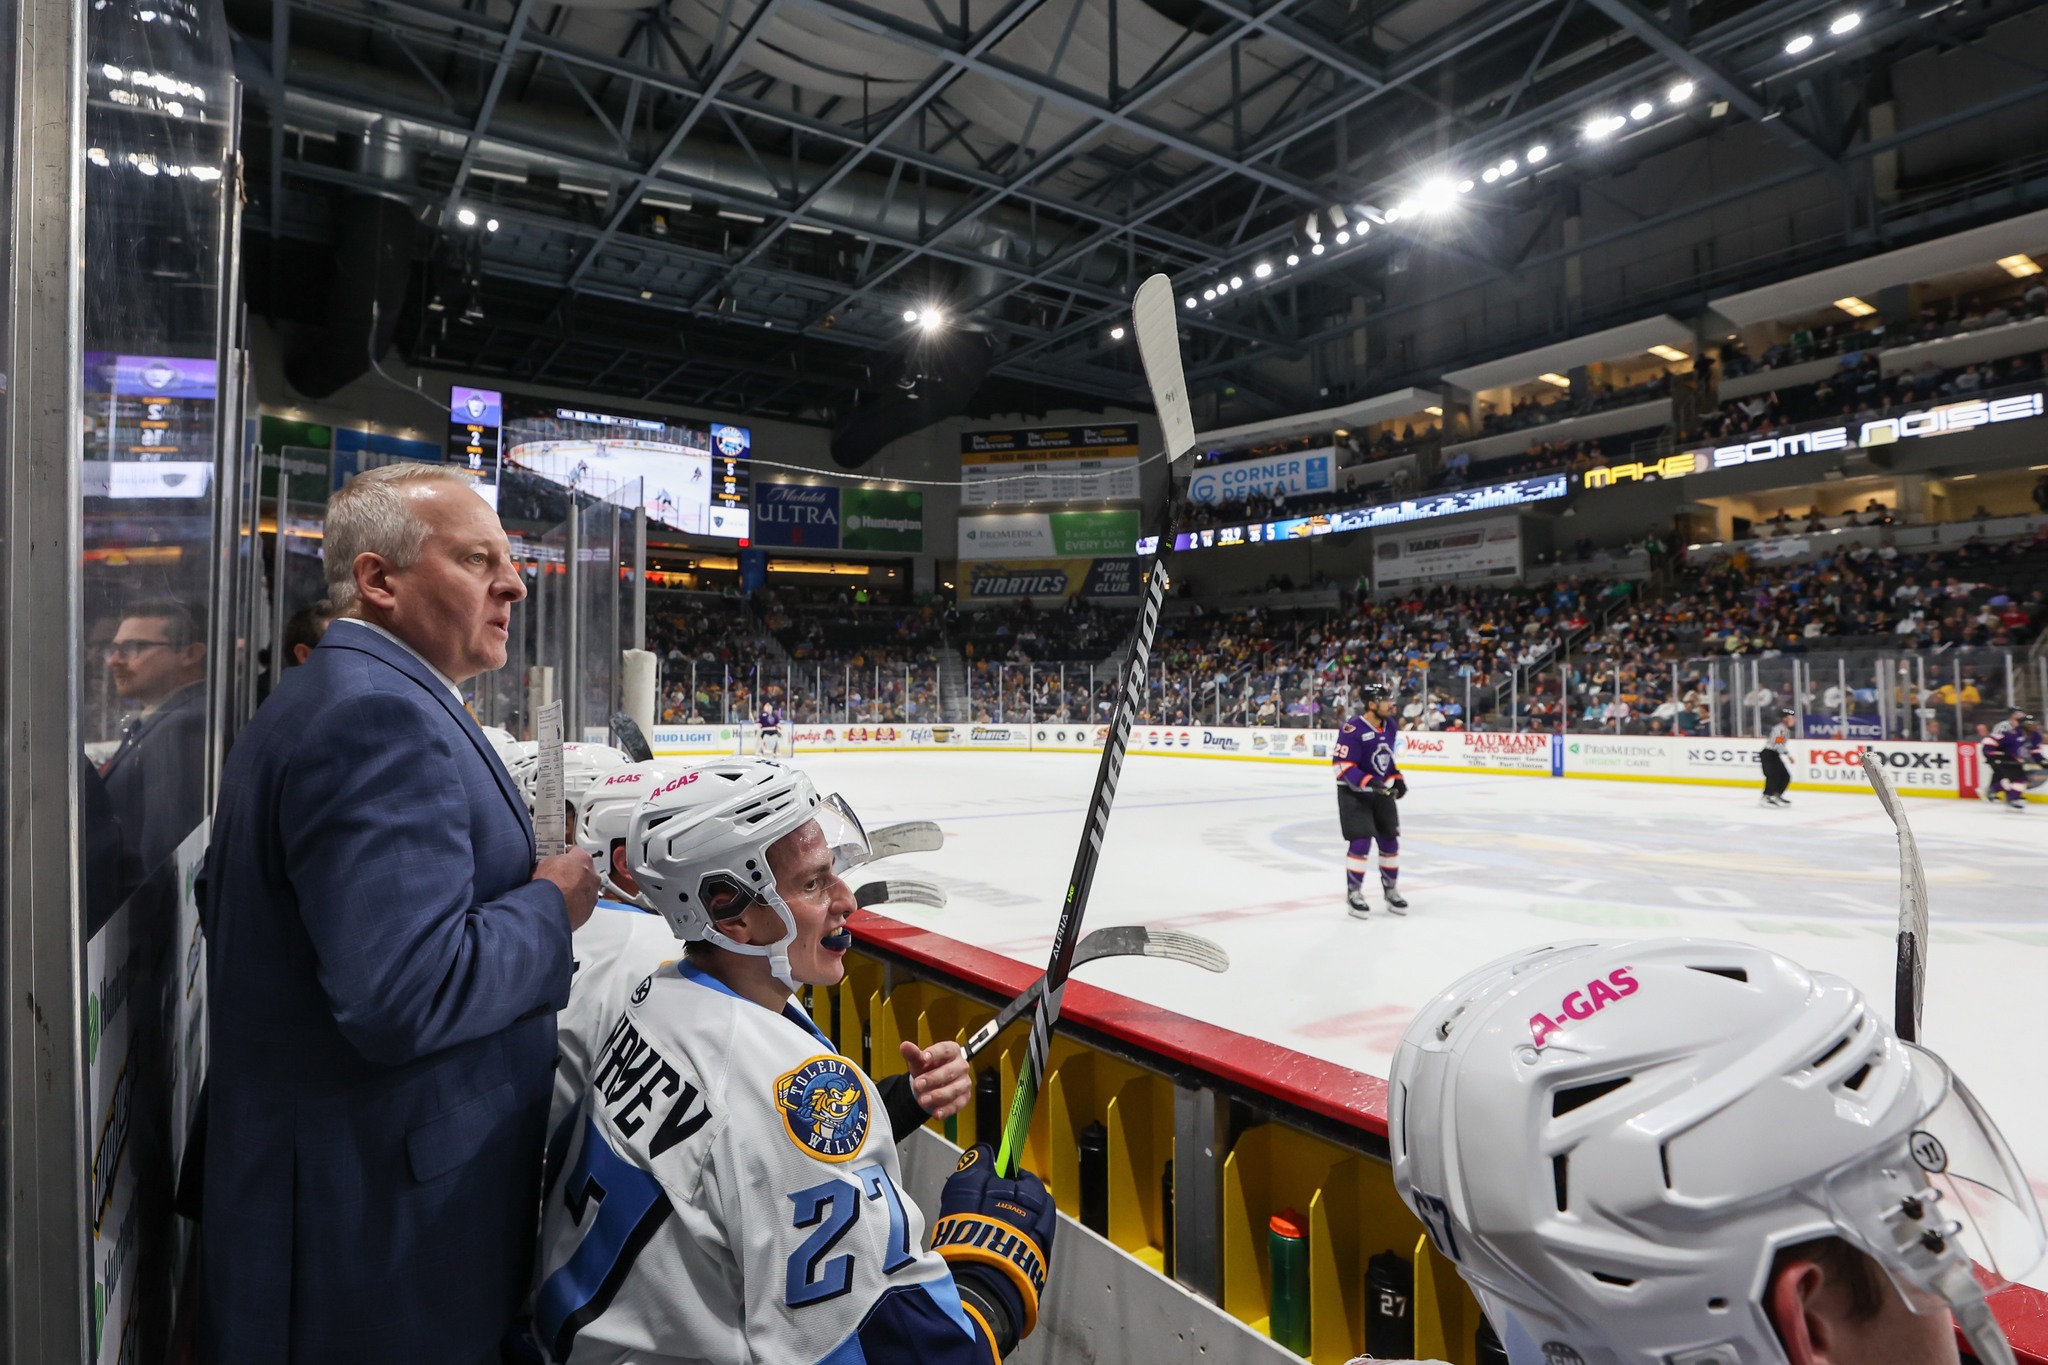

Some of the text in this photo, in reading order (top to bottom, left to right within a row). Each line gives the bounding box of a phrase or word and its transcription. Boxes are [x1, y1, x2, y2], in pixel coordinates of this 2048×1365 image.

[471, 432, 480, 446] 2
[1584, 392, 2044, 489] MAKE SOME NOISE!
[727, 463, 735, 476] 5
[1222, 461, 1300, 485] CORNER
[1222, 479, 1300, 501] DENTAL
[756, 503, 838, 526] ULTRA
[862, 515, 922, 532] Huntington
[1065, 540, 1099, 550] EVERY
[1103, 538, 1127, 549] DAY
[1190, 533, 1198, 549] 2
[1220, 528, 1241, 541] 33.9
[1266, 523, 1275, 541] 5
[1097, 562, 1130, 572] JOIN
[1103, 572, 1129, 582] THE
[1095, 582, 1130, 593] CLUB
[654, 733, 712, 743] BUD LIGHT
[1203, 731, 1233, 750] Dunn
[1465, 733, 1547, 747] BAUMANN
[1335, 744, 1349, 759] 29
[1474, 745, 1537, 755] AUTO GROUP
[1625, 759, 1650, 768] CARE
[605, 774, 642, 785] A-GAS
[1810, 768, 1952, 786] DUMPTERS
[650, 772, 701, 800] A-GAS
[1053, 913, 1069, 960] ALPHA
[1529, 967, 1639, 1048] A-GAS
[790, 1060, 847, 1096] TOLEDO
[808, 1111, 868, 1154] WALLEYE
[995, 1201, 1028, 1217] COVERT
[785, 1164, 918, 1310] 27
[1379, 1293, 1408, 1318] 27
